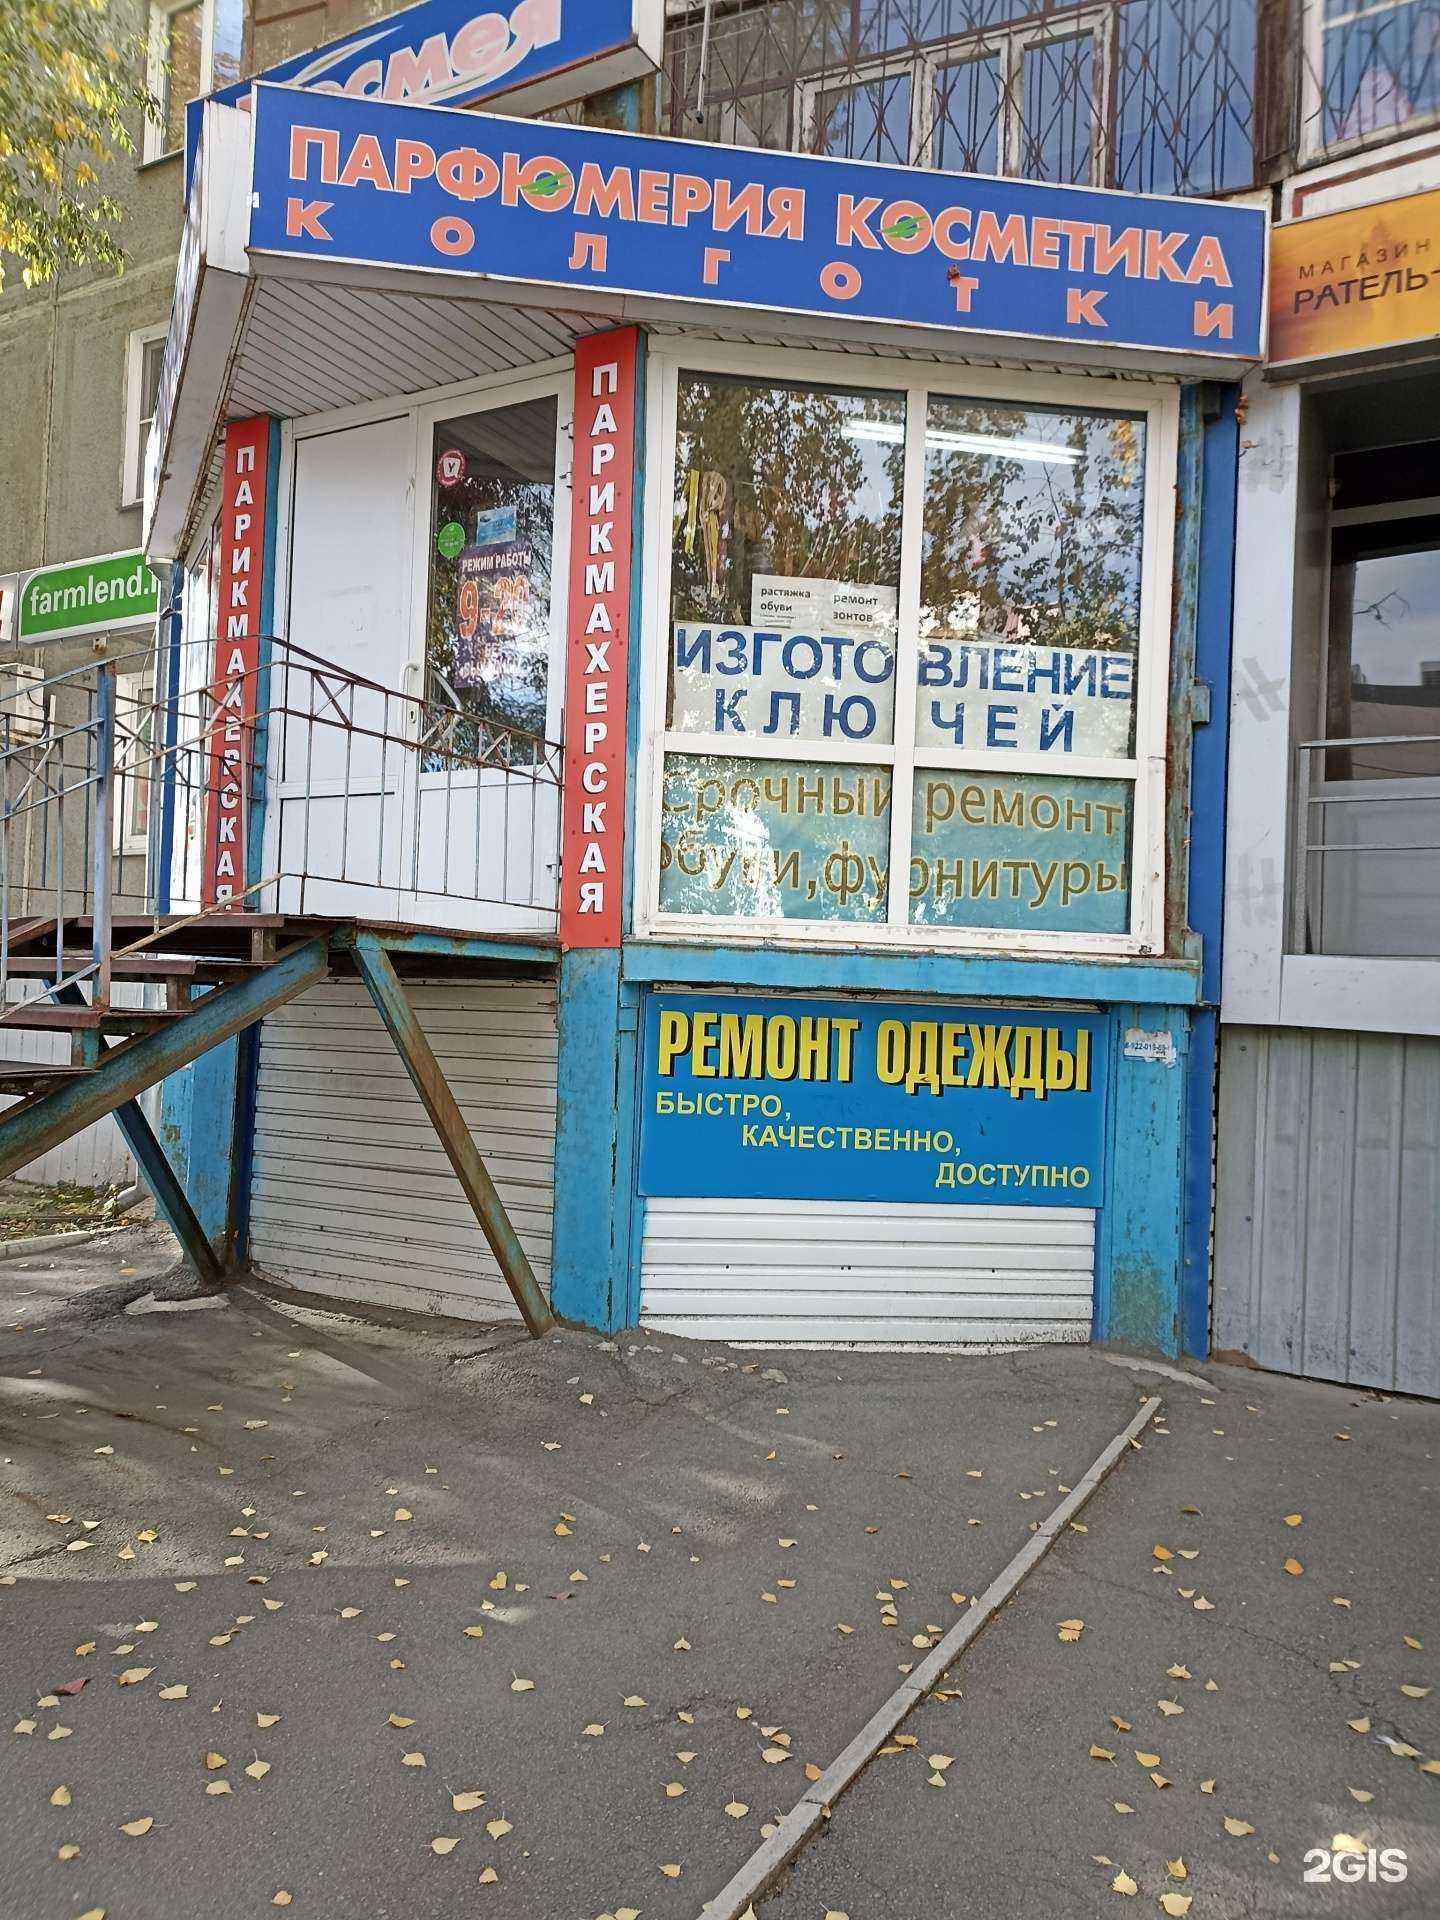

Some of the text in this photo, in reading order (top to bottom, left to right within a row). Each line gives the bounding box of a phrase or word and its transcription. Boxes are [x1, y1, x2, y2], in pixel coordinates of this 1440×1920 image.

[288, 124, 1234, 288] ПАРФЮМЕРИЯ КОСМЕТИКА
[1298, 237, 1432, 280] МАГАЗИН
[462, 550, 532, 573] РЕЖИМ РАБОТЫ
[760, 587, 811, 599] растяжка
[760, 601, 793, 613] обуви
[833, 593, 879, 606] ремонт
[833, 610, 874, 623] зонтов
[577, 362, 619, 914] ПАРИКМАХЕРСКАЯ
[926, 782, 1123, 836] ремонт
[657, 1010, 1092, 1101] РЕМОНТ ОДЕЖДЫ
[655, 1090, 792, 1121] БЫСТРО,
[741, 1124, 961, 1157] КАЧЕСТВЕННО,
[934, 1162, 1090, 1188] ДОСТУПНО
